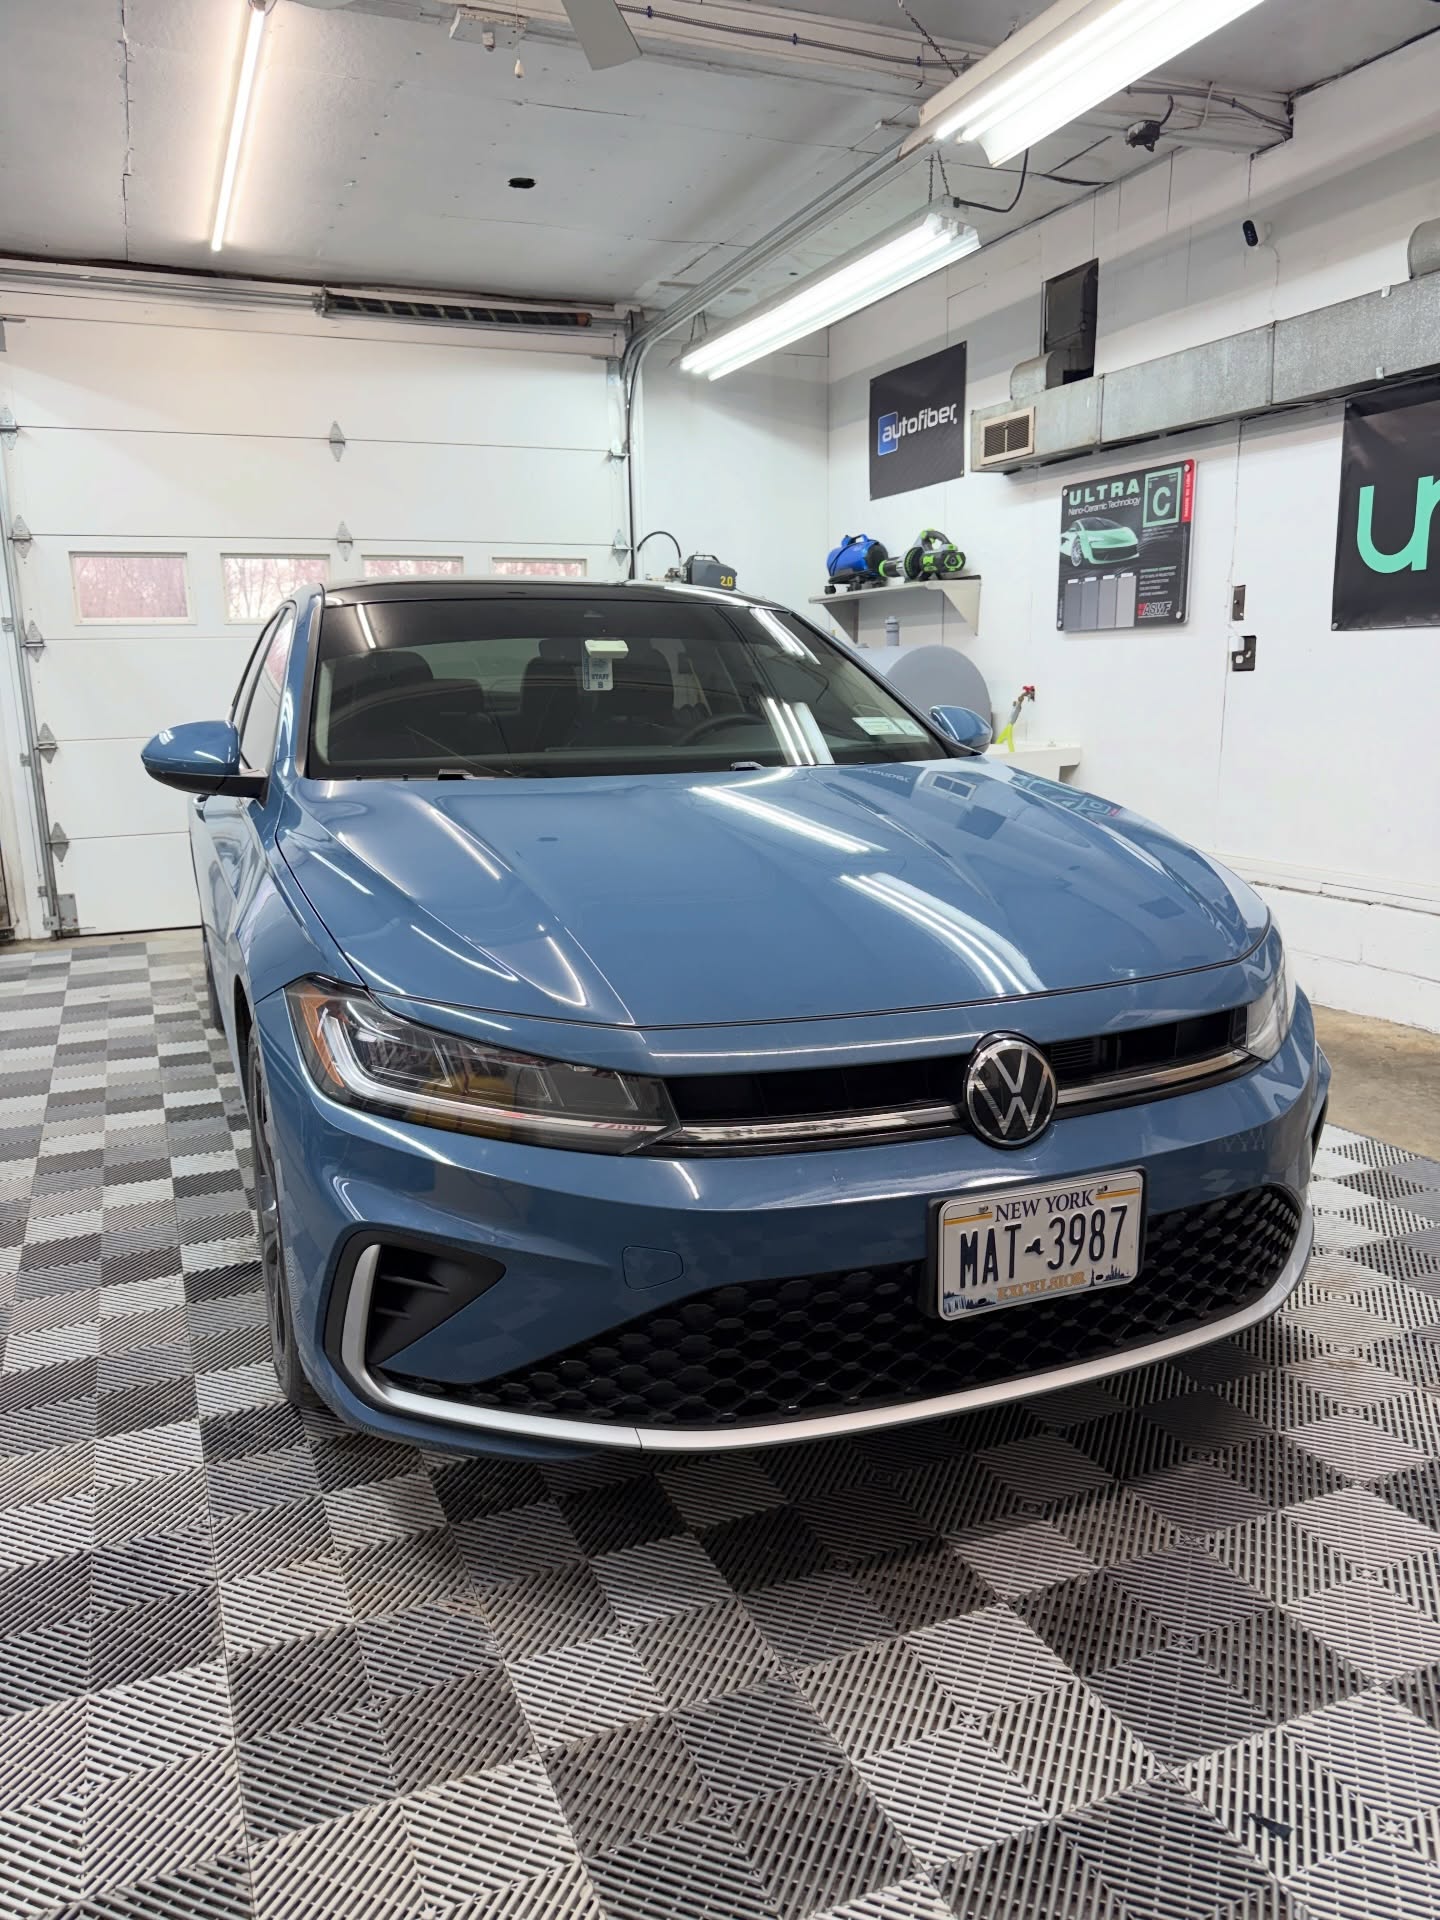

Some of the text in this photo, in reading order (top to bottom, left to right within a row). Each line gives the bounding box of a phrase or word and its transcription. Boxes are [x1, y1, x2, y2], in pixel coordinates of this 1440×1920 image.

[882, 403, 957, 443] autofiber
[1069, 478, 1140, 506] ULTRA
[1108, 496, 1141, 509] Technology
[1152, 486, 1171, 516] C
[995, 1189, 1095, 1222] NEW YORK
[960, 1205, 1128, 1289] MAT 3987
[996, 1271, 1087, 1301] EXCELSIOR
